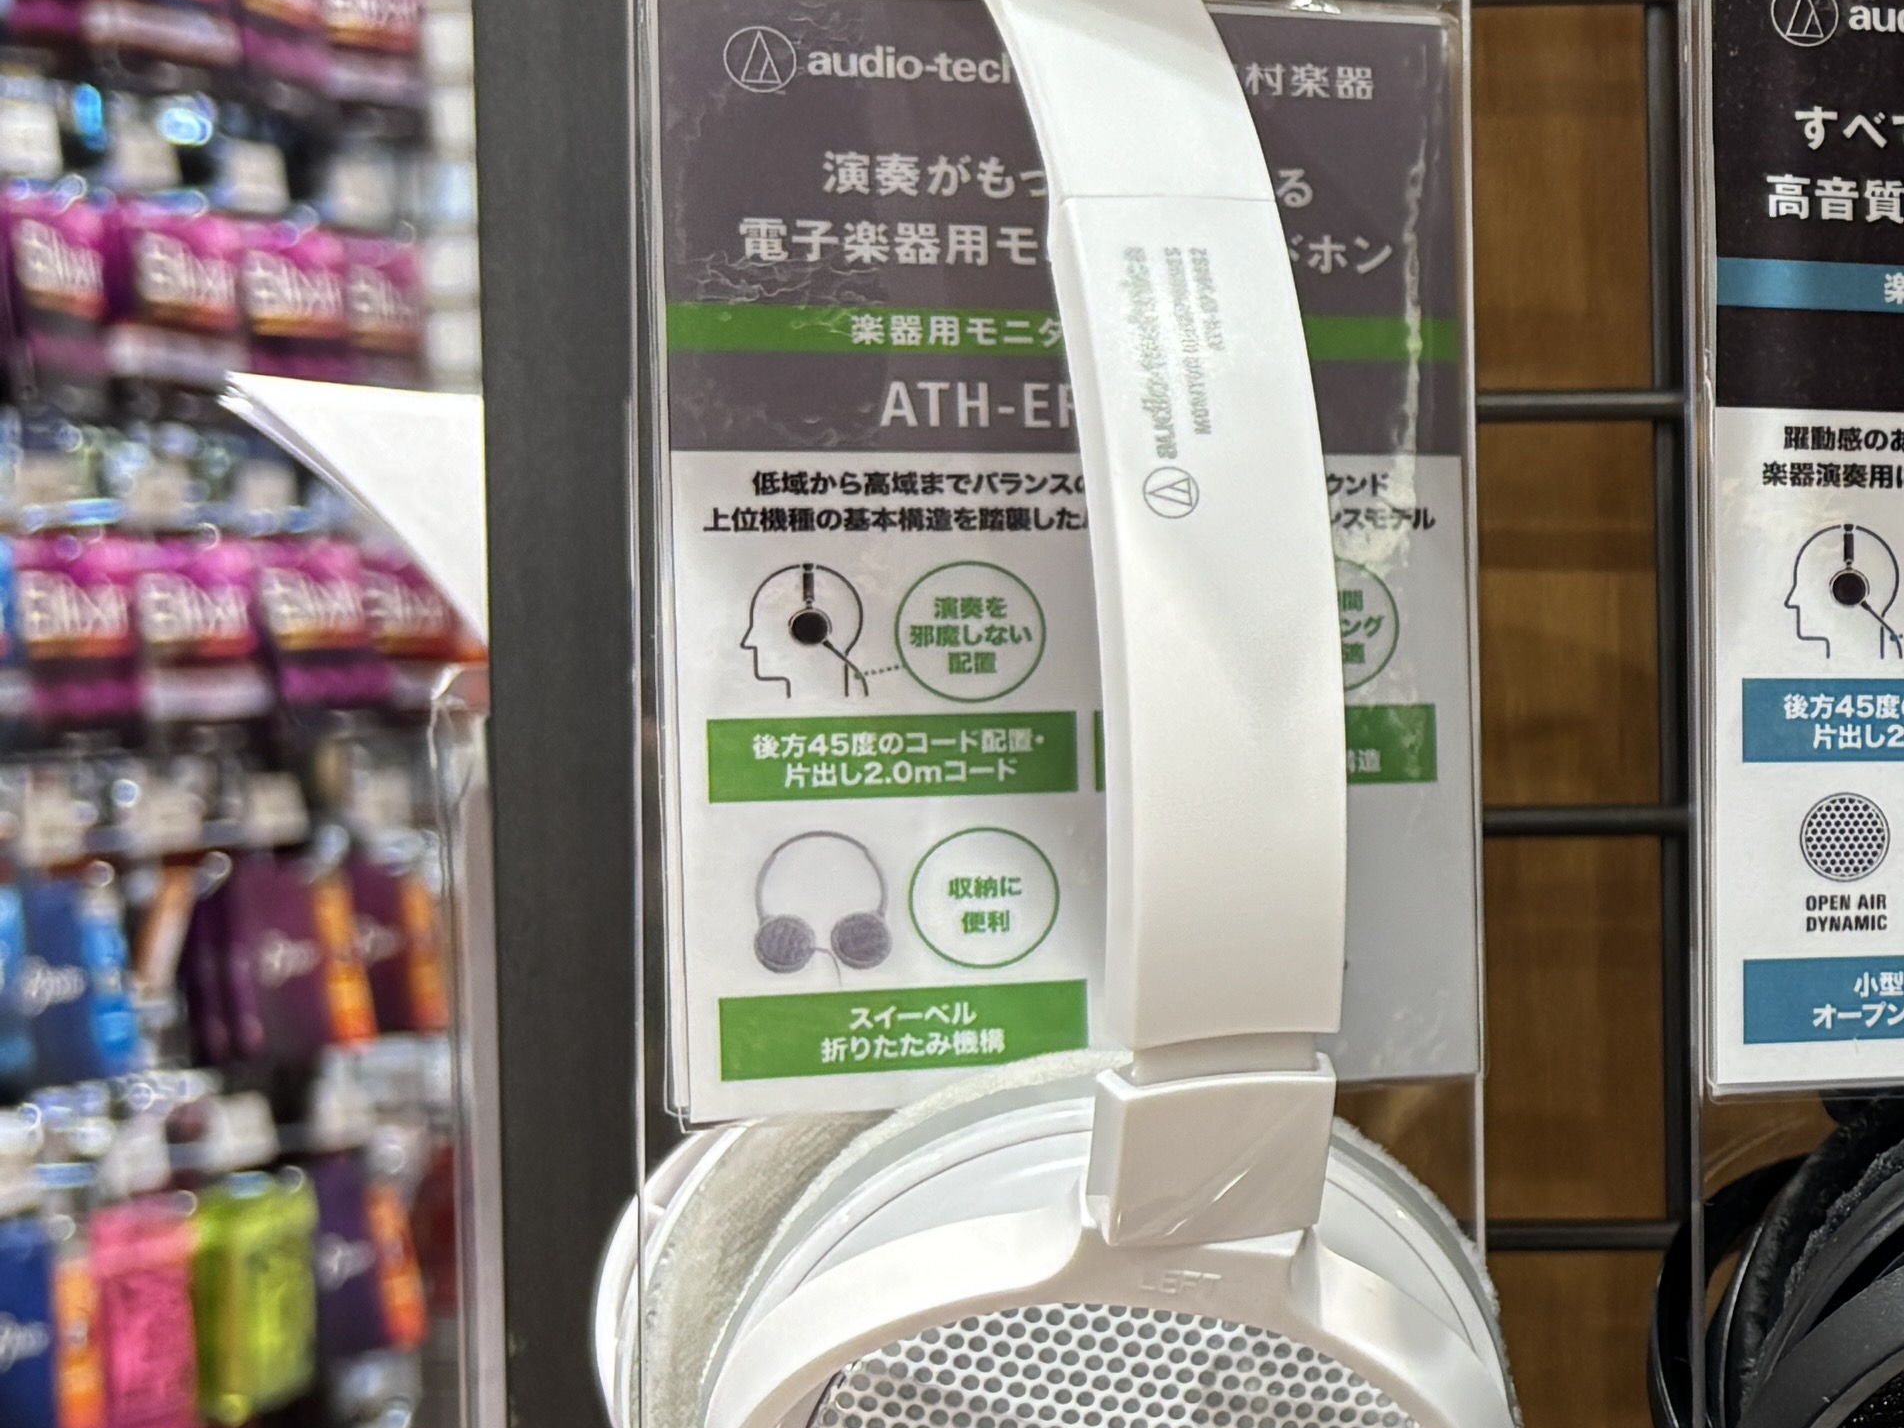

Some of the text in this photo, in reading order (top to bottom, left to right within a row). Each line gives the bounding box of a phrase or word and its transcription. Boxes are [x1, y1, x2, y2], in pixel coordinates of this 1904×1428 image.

[1233, 62, 1375, 100] 村楽器
[822, 150, 1048, 199] 演奏がもっ
[738, 217, 1039, 267] 電子楽器用モ
[851, 314, 1063, 348] 楽器用モニタ
[703, 506, 1088, 534] 上位機種の基本構造を踏襲した
[934, 596, 1008, 620] 演奏を
[1338, 589, 1364, 613] 間
[909, 624, 1033, 648] 邪魔しない
[784, 758, 1018, 789] 片出し2.0mコード
[948, 876, 1022, 900] 収納に
[1805, 893, 1887, 911] OPEN AIR
[961, 909, 1010, 934] 便利
[1805, 914, 1888, 933] DYNAMIC
[849, 1001, 978, 1030] スイーベル
[820, 1028, 1006, 1064] 折りたたみ機構
